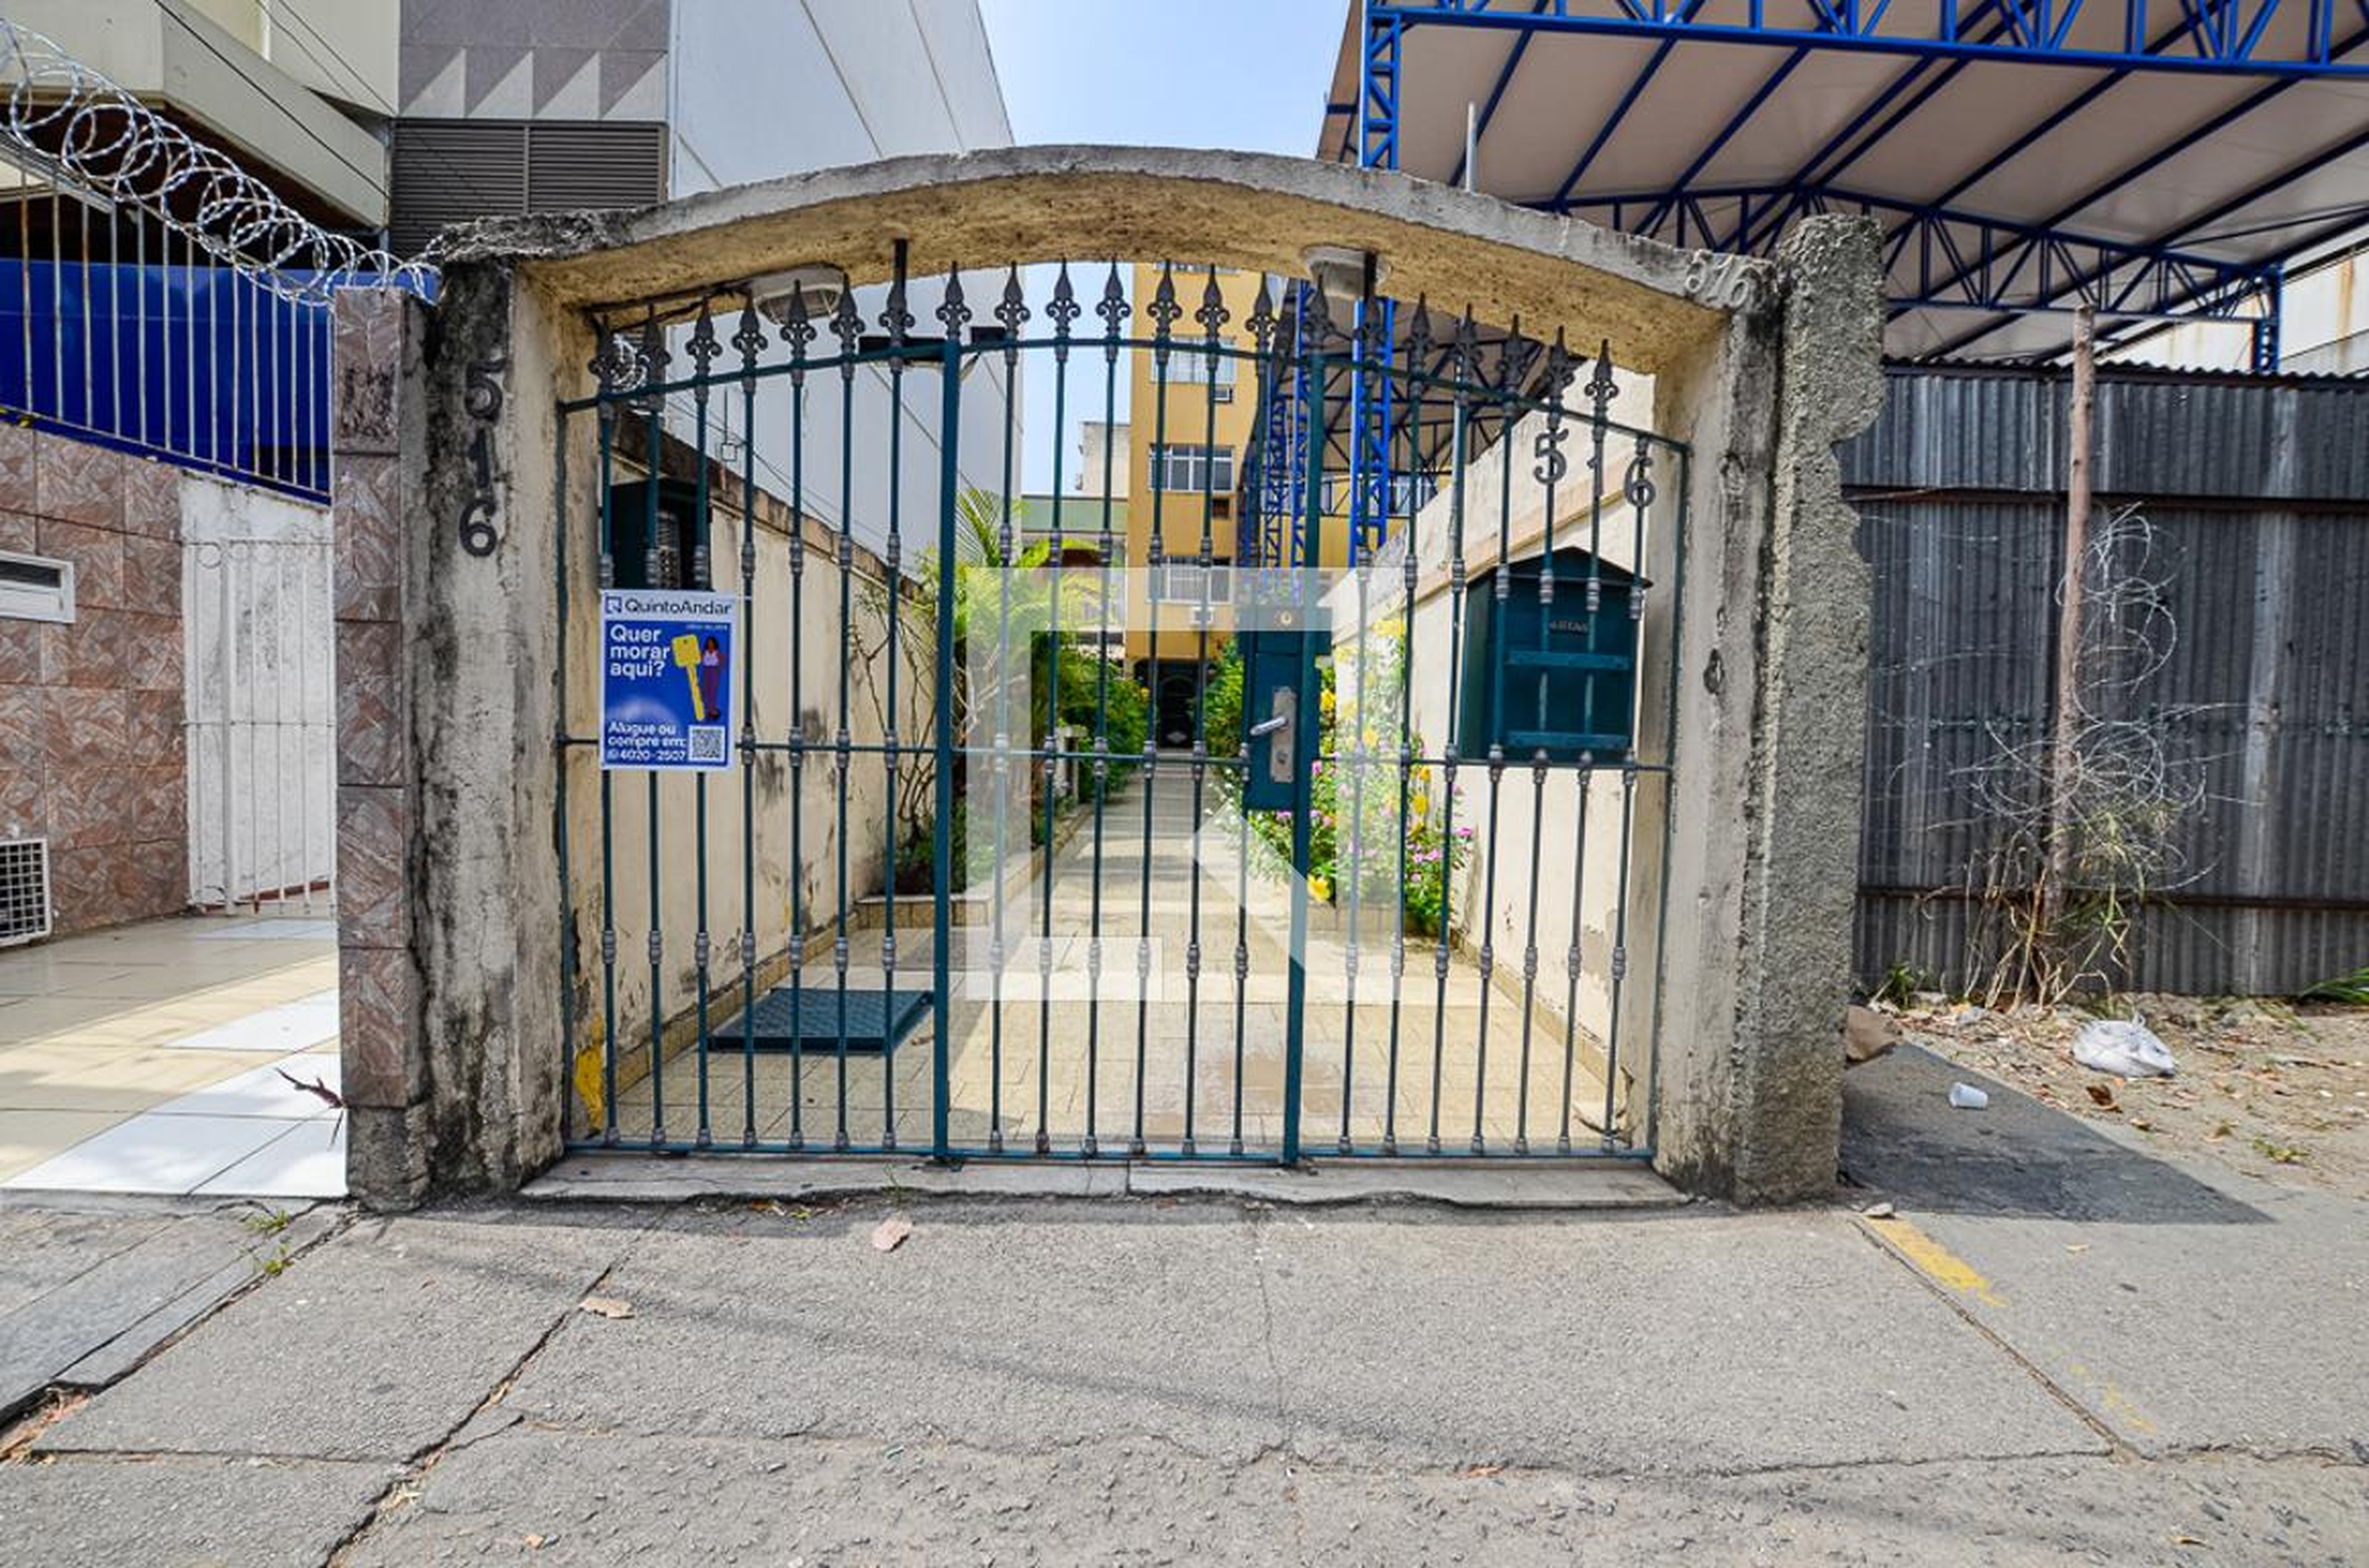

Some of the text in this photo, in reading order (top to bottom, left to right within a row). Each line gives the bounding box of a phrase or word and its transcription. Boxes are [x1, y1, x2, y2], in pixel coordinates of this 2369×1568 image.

[459, 359, 505, 557] 516
[625, 598, 730, 614] QuintoAndar
[610, 624, 661, 642] Quer
[610, 646, 670, 659] morar
[610, 661, 664, 680] aqui?
[608, 721, 676, 737] Alugue ou
[608, 737, 686, 750] compre em:
